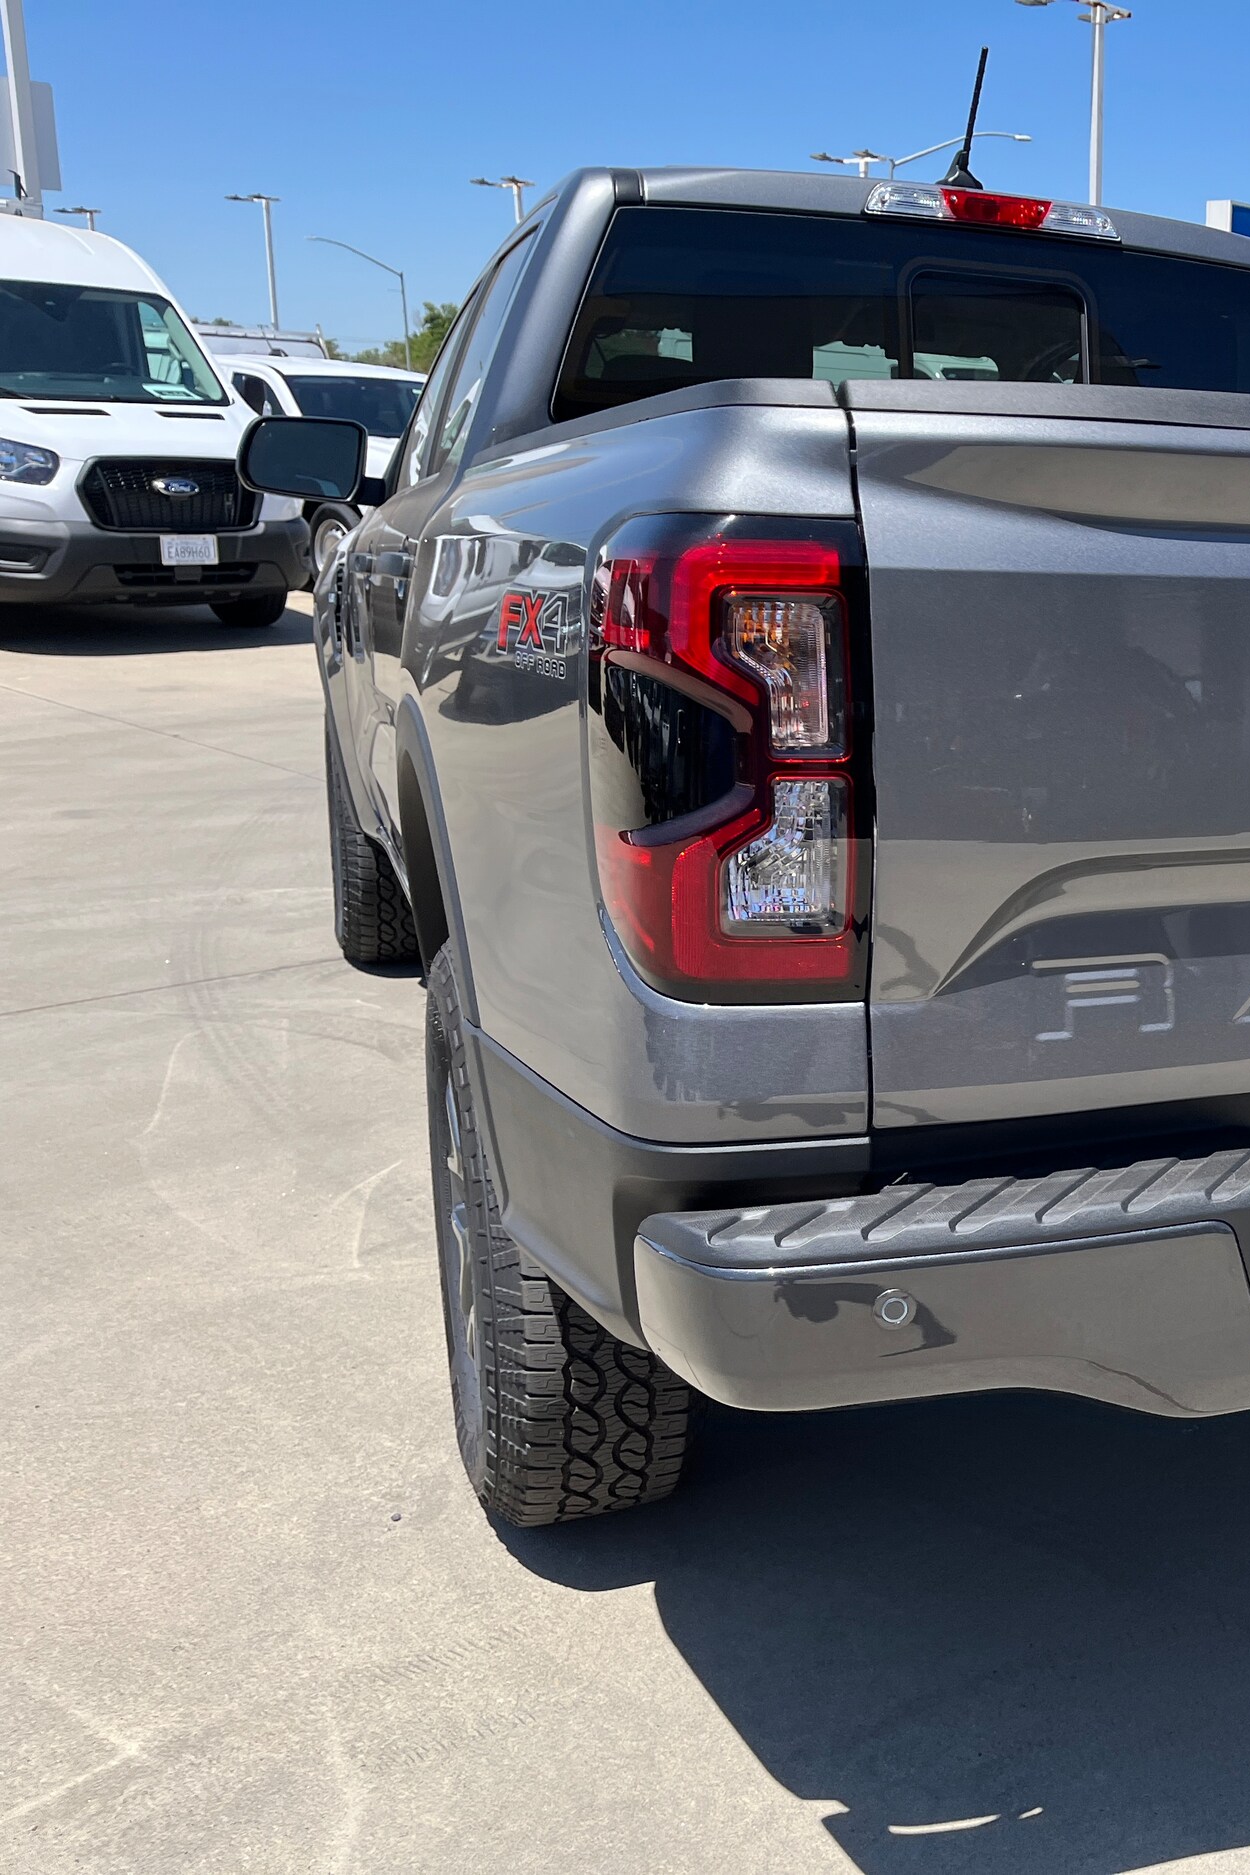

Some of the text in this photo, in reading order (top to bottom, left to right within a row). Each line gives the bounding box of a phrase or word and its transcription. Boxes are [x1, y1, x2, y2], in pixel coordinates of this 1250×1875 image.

[496, 587, 569, 658] FX4
[514, 651, 567, 680] OFF ROAD
